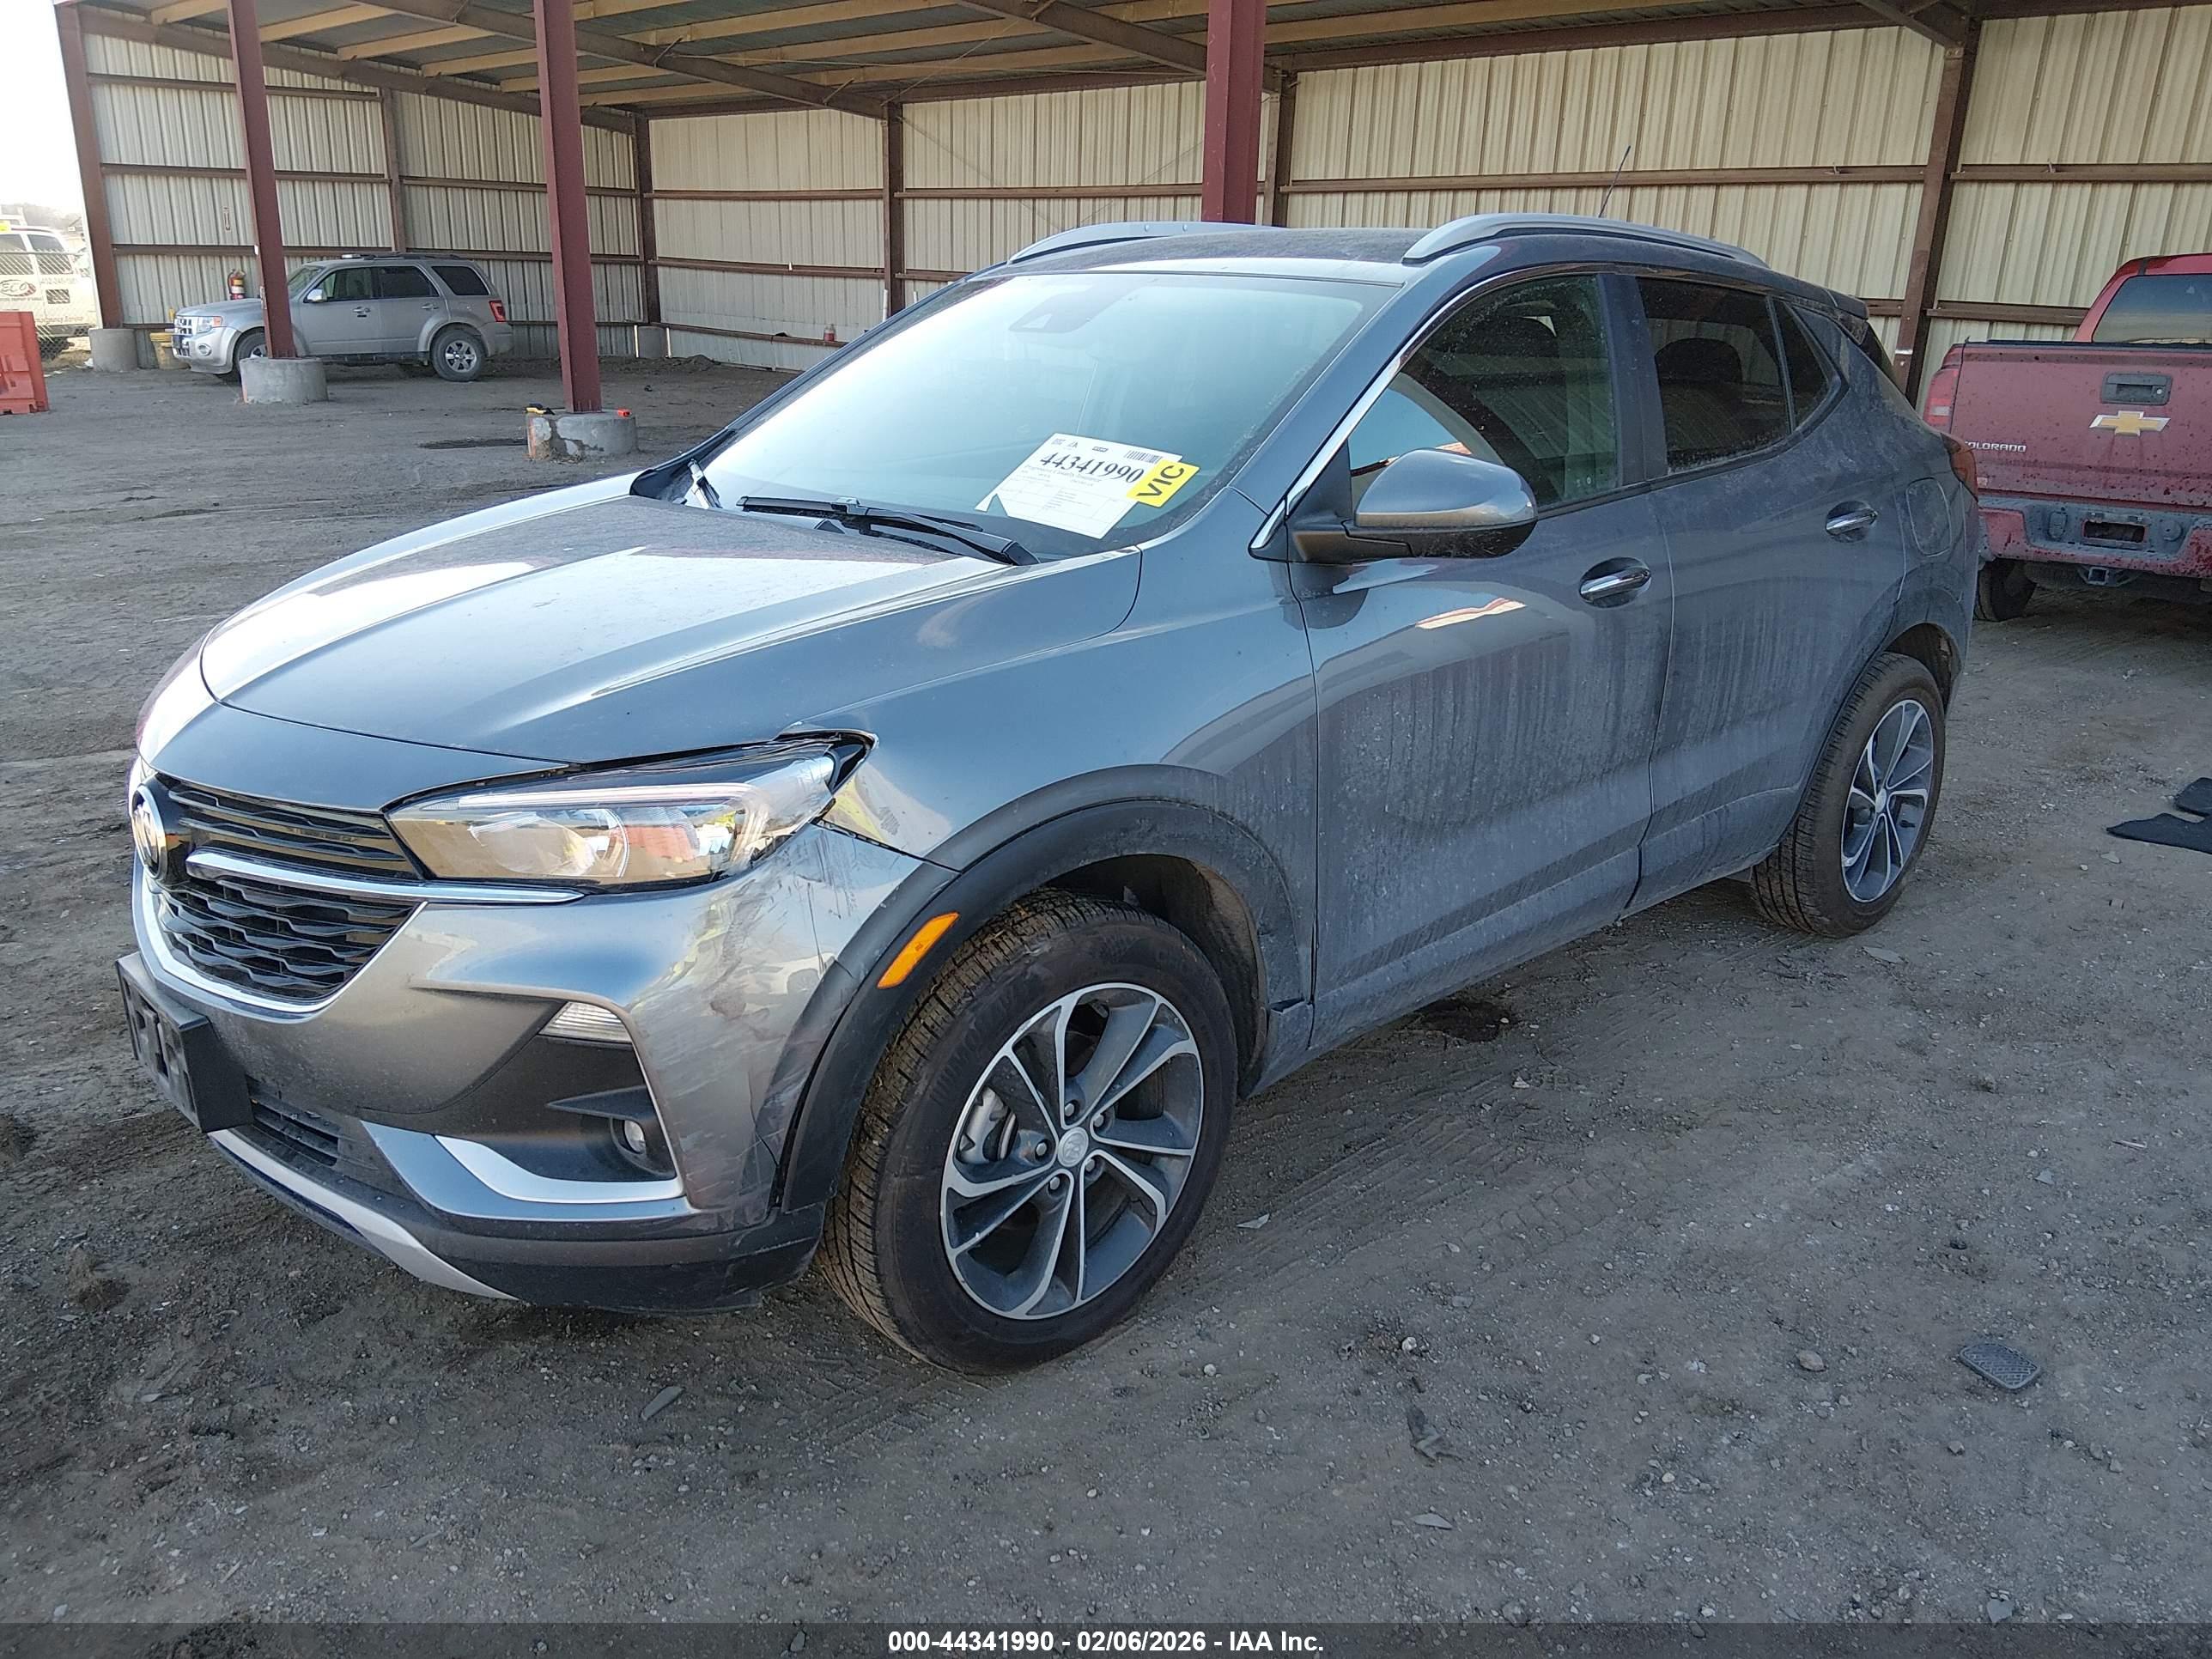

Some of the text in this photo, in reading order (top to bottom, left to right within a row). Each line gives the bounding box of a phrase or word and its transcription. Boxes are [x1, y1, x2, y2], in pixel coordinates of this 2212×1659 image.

[1965, 441, 2027, 453] OLORADO
[1040, 452, 1145, 483] 44341990
[1136, 465, 1185, 497] VIC
